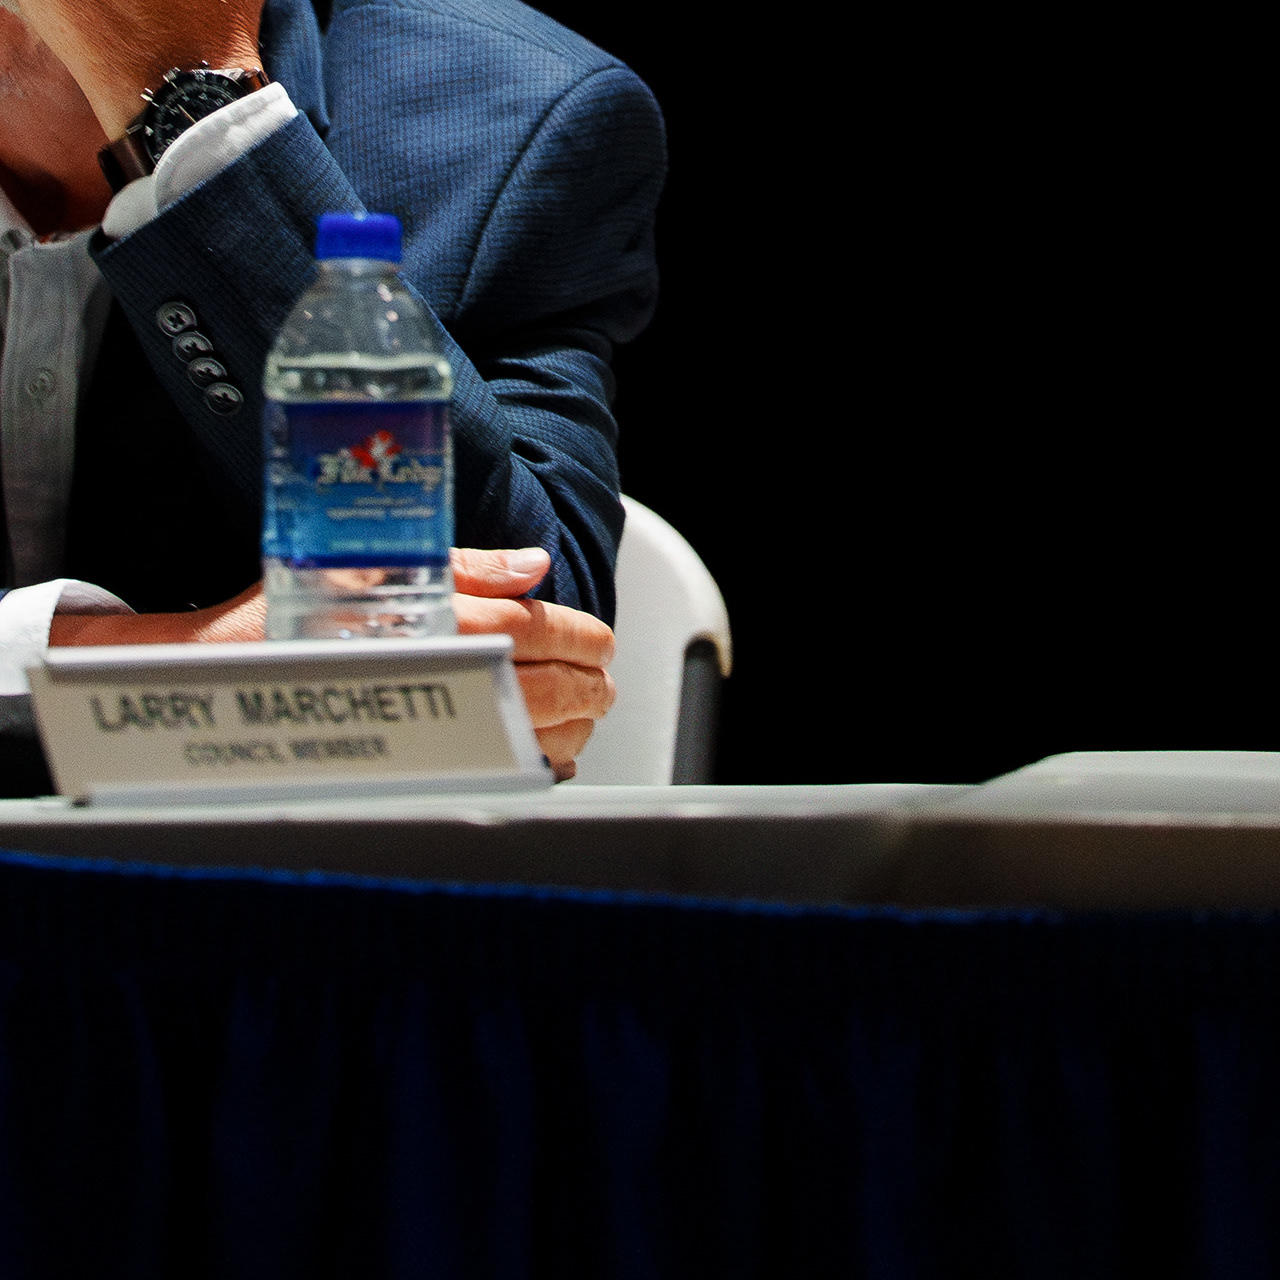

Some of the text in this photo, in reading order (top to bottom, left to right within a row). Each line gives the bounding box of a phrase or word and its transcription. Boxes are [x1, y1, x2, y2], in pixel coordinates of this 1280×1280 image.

[89, 682, 457, 733] LARRY MARCHETTI
[183, 734, 391, 767] COUNCIL MEMBER
